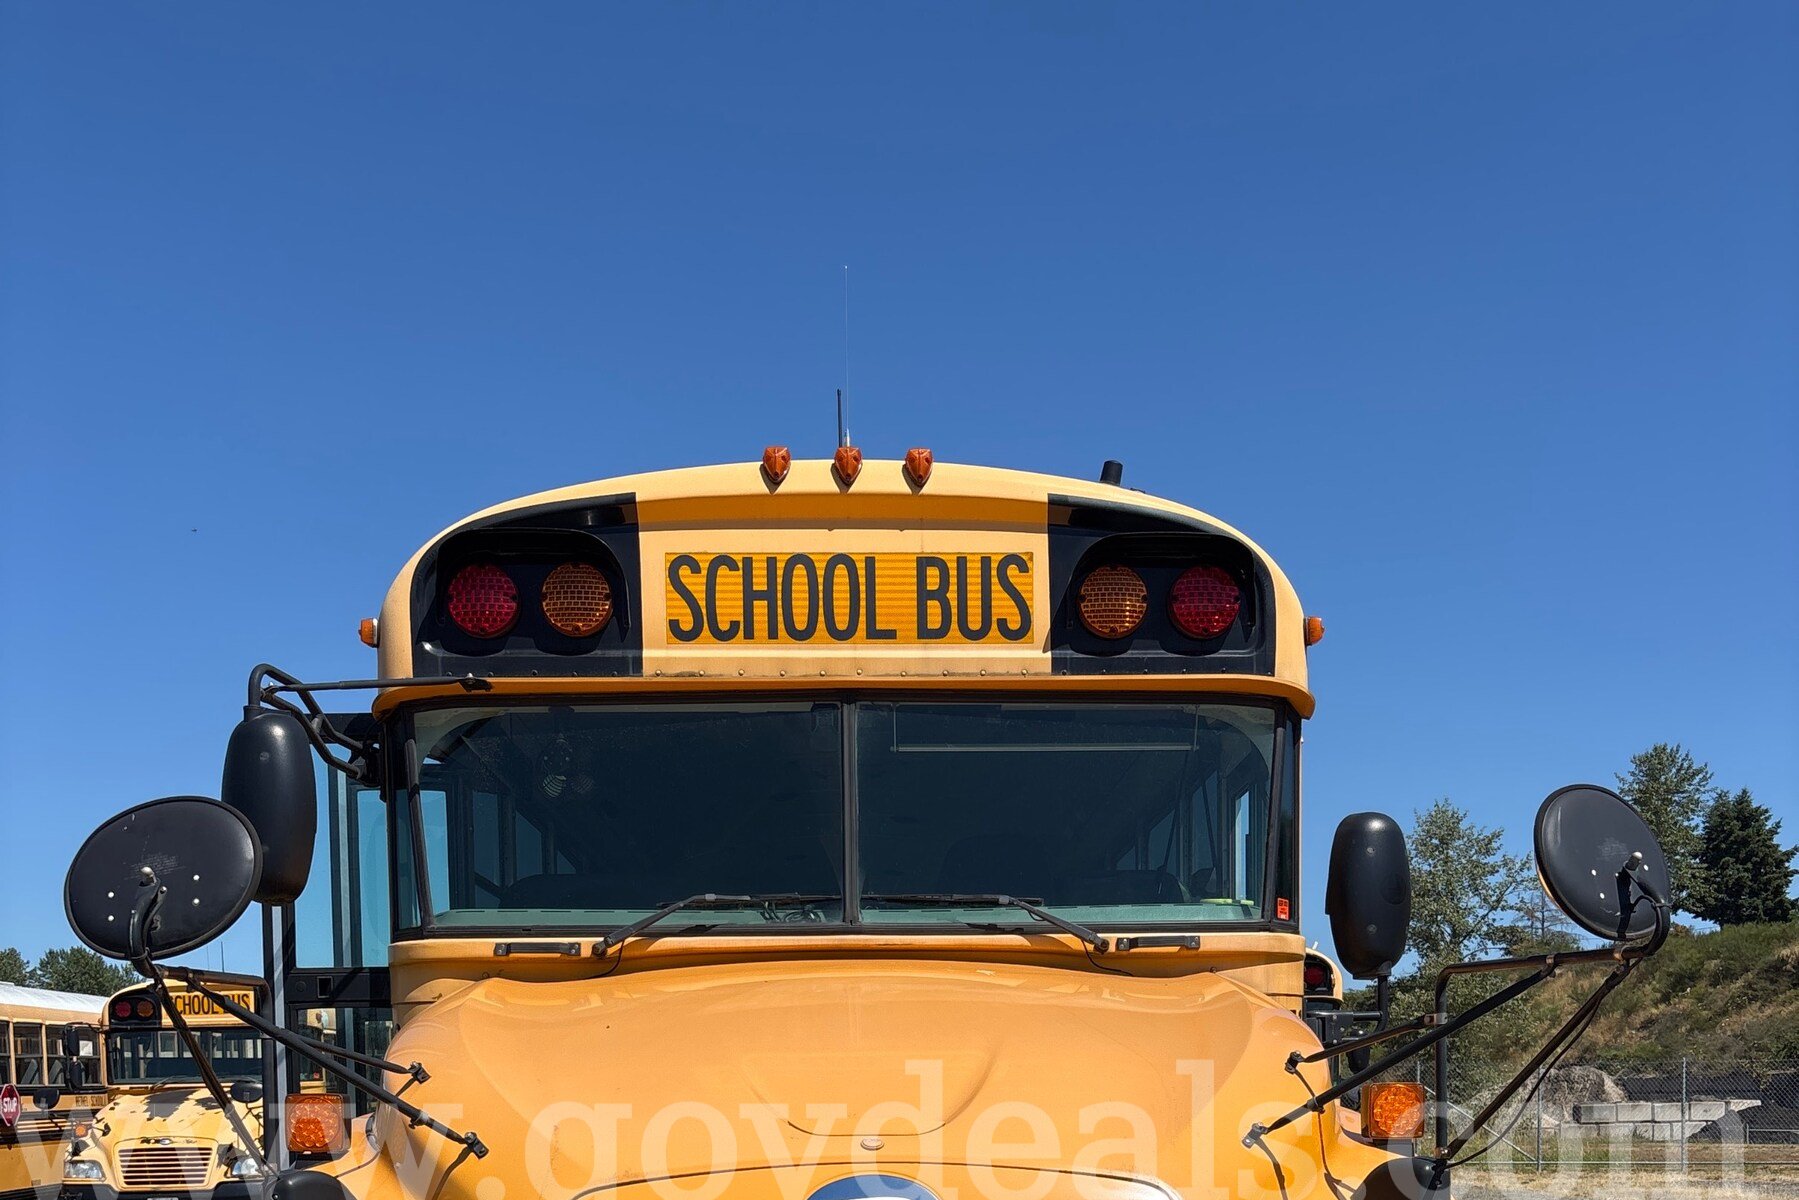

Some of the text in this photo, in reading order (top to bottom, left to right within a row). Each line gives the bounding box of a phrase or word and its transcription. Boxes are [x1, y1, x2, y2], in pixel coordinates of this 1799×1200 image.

[668, 553, 1031, 642] SCHOOL BUS
[166, 994, 219, 1015] CHOOL
[3, 1097, 18, 1113] STOP
